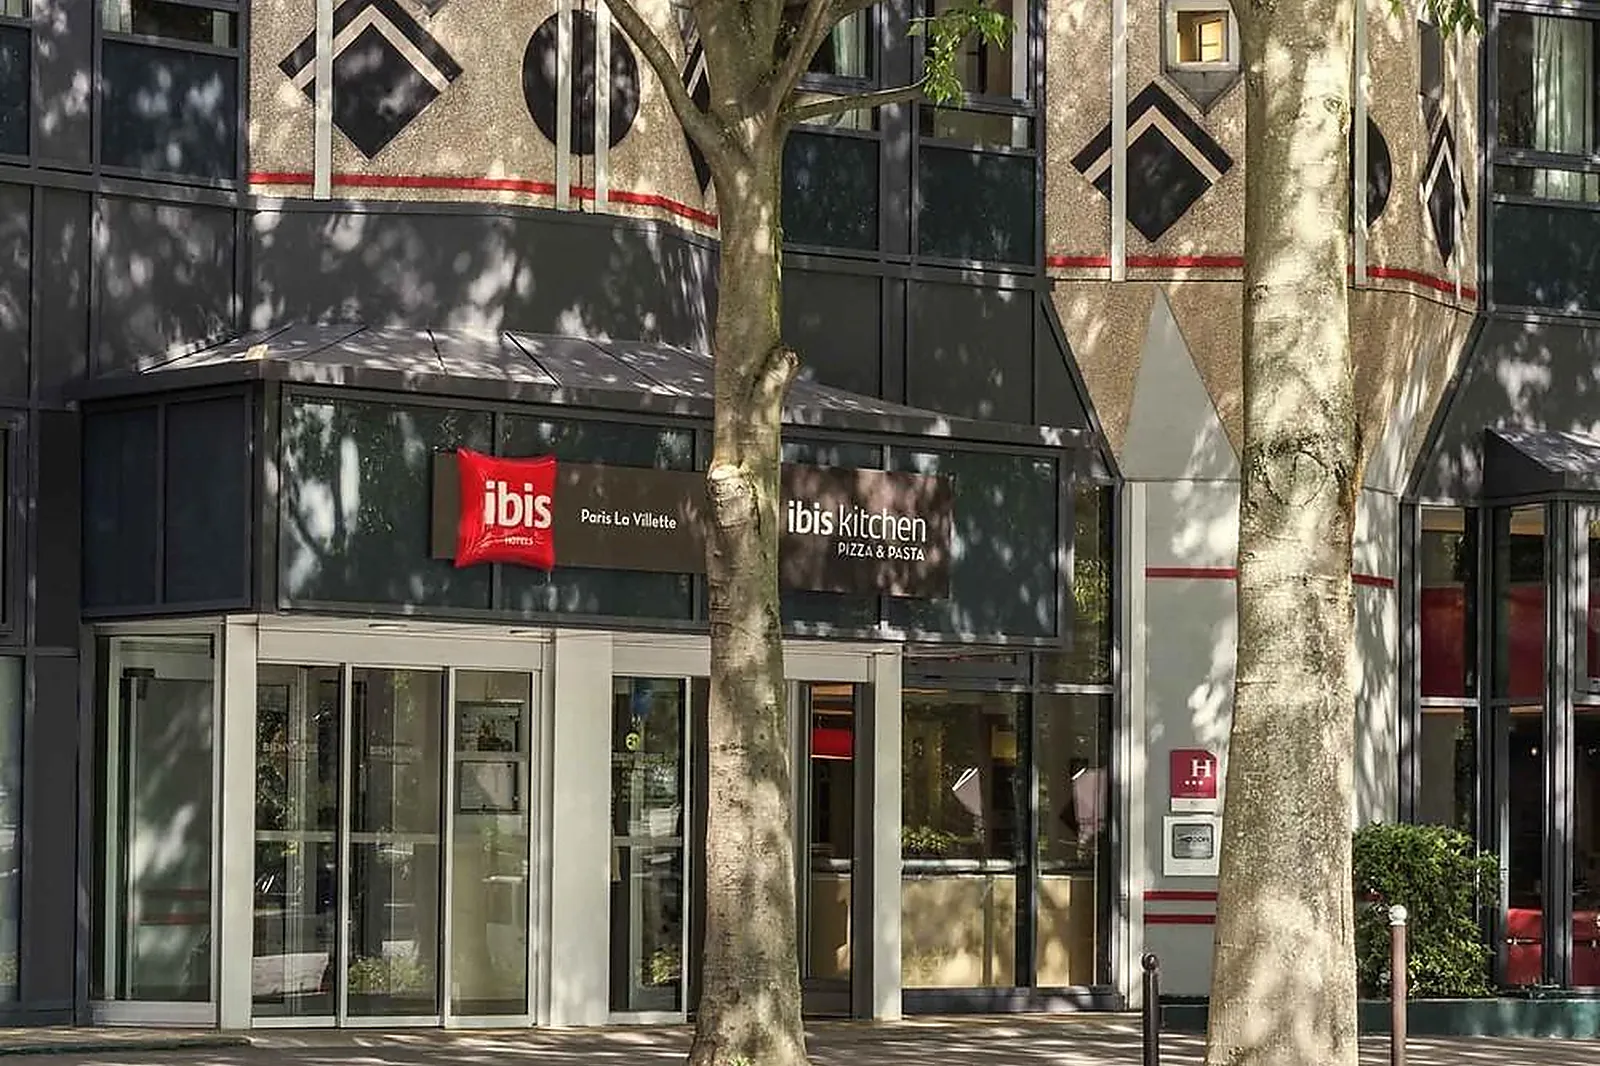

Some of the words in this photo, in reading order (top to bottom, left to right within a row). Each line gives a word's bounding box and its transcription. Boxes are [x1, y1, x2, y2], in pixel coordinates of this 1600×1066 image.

[484, 480, 552, 529] ibis
[581, 508, 612, 525] Paris
[615, 511, 630, 526] La
[633, 512, 677, 529] Villette
[788, 500, 834, 535] ibis
[839, 504, 926, 542] kitchen
[838, 542, 873, 557] PIZZA
[876, 546, 885, 558] &
[888, 546, 925, 561] PASTA
[1192, 760, 1211, 777] H
